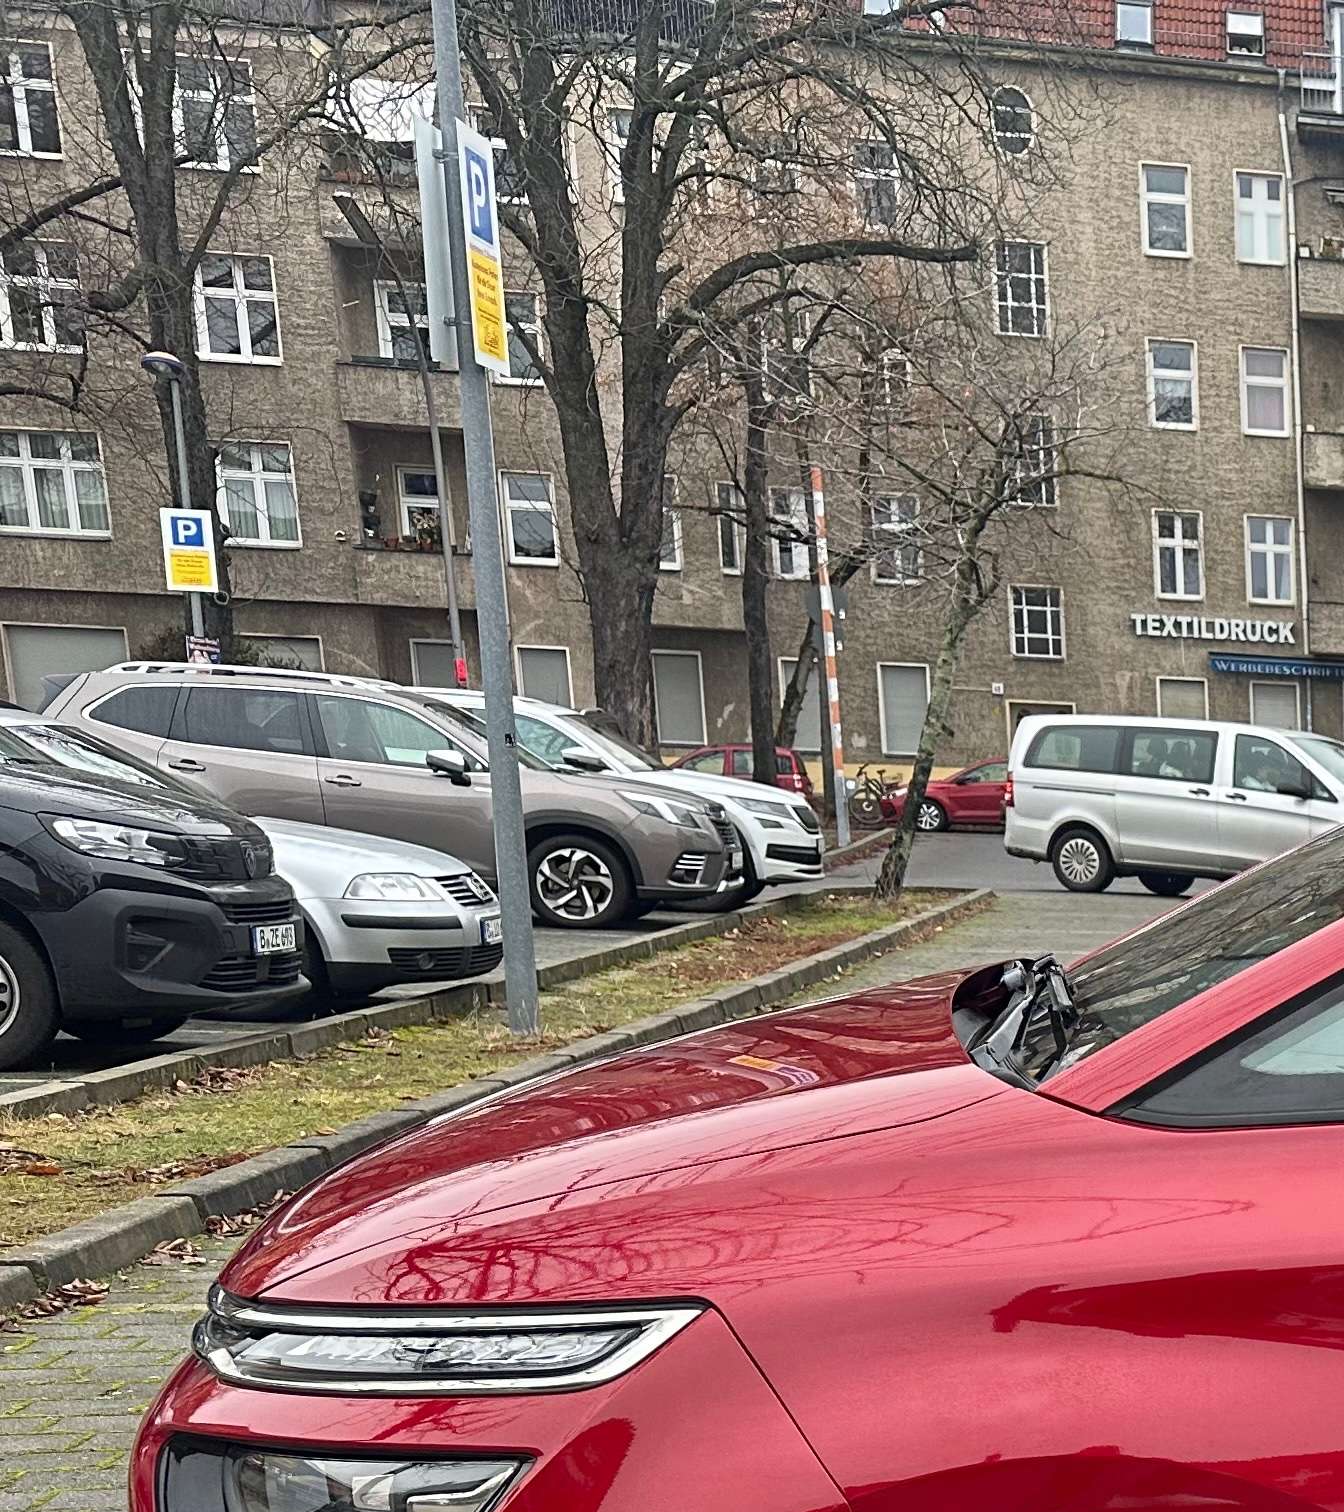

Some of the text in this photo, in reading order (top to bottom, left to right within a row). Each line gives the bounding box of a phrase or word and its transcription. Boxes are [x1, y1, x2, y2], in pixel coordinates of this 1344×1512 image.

[469, 159, 487, 227] P
[176, 519, 198, 544] P
[1130, 613, 1297, 644] TEXTILDRUCK
